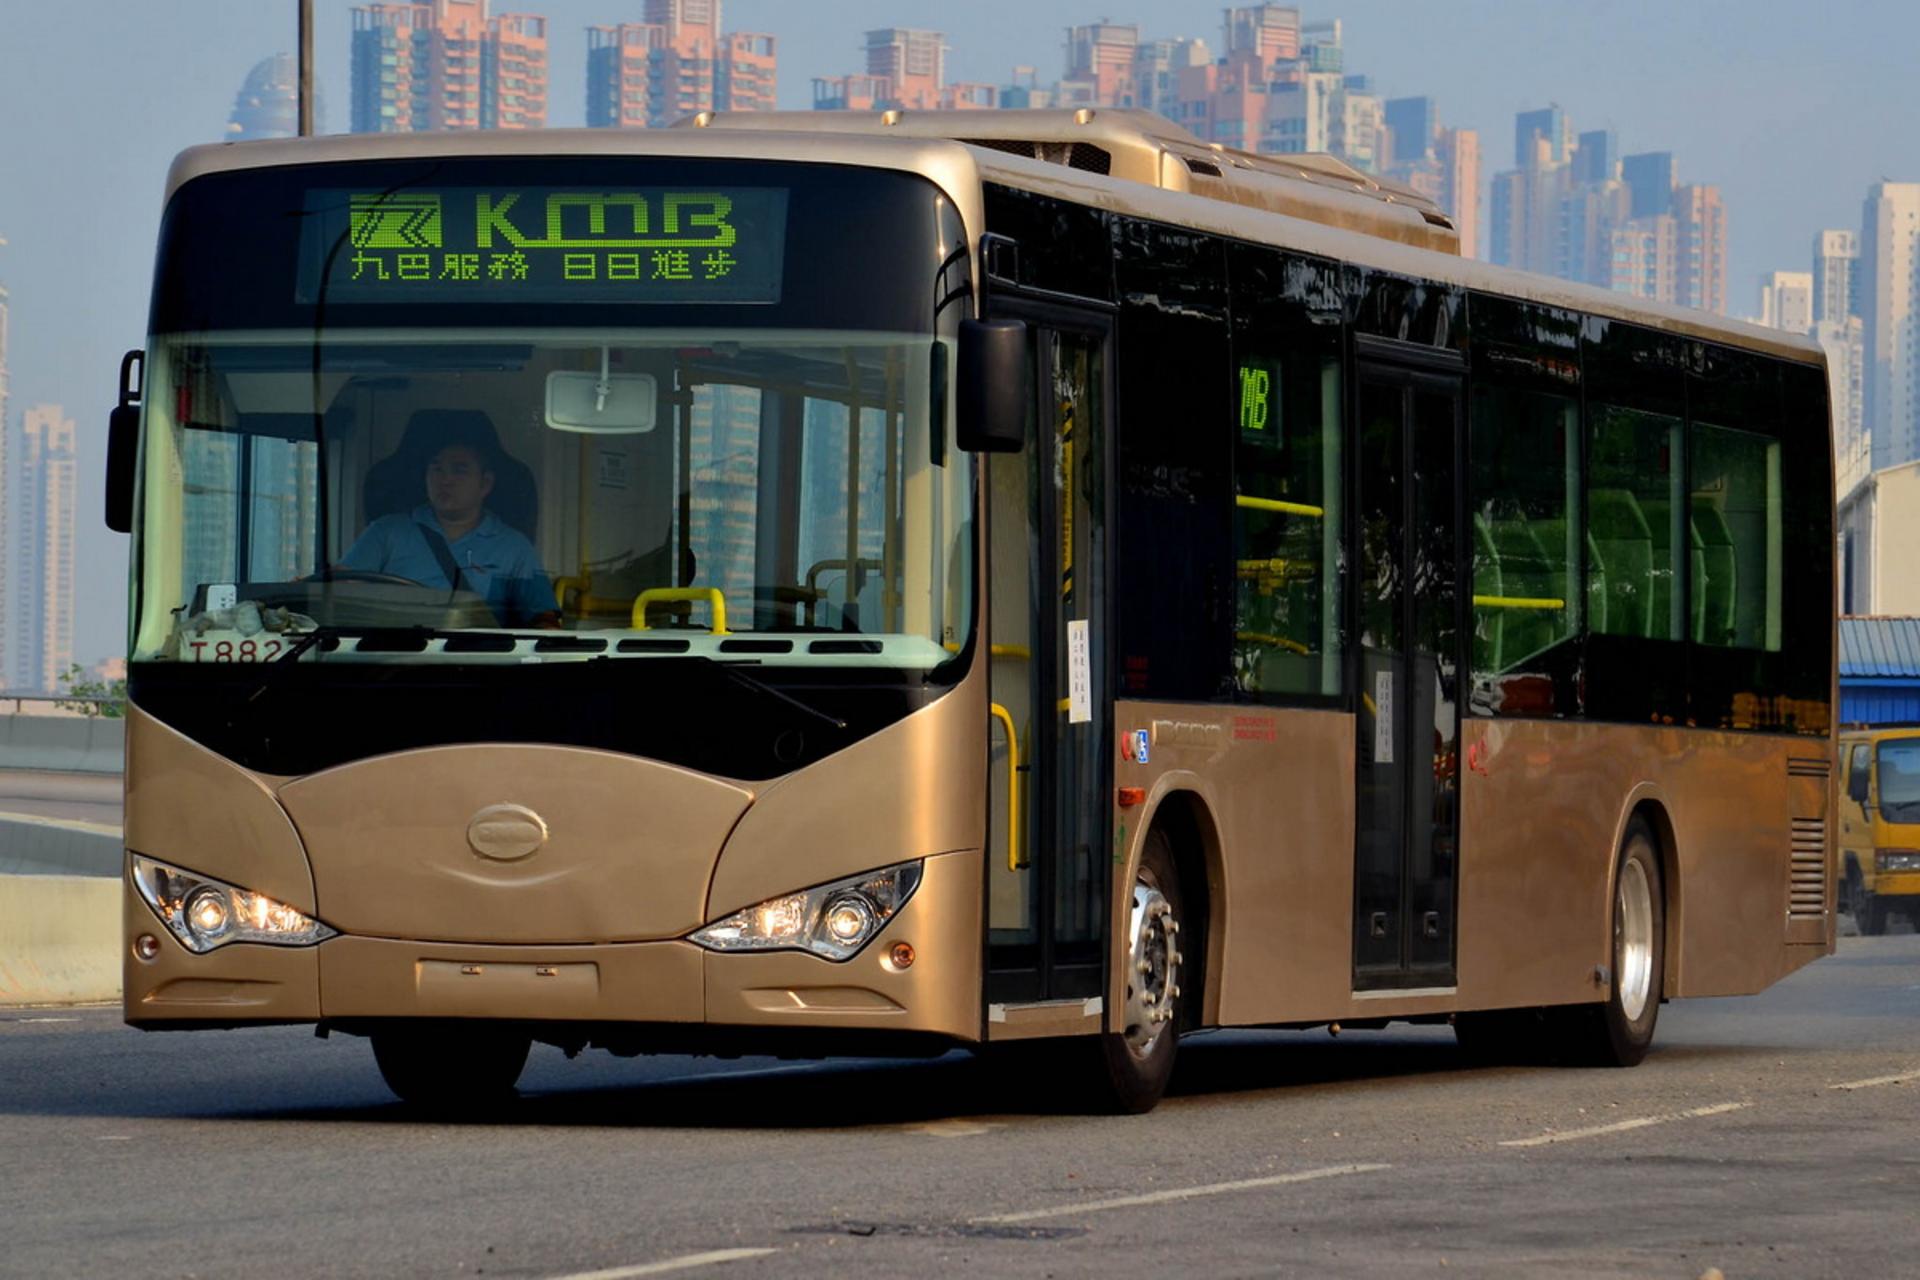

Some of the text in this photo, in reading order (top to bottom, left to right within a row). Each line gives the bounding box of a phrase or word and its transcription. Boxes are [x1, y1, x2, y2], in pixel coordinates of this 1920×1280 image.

[476, 192, 736, 248] KMB
[351, 250, 737, 281] 九巴服務 日日進步
[190, 640, 298, 663] T882
